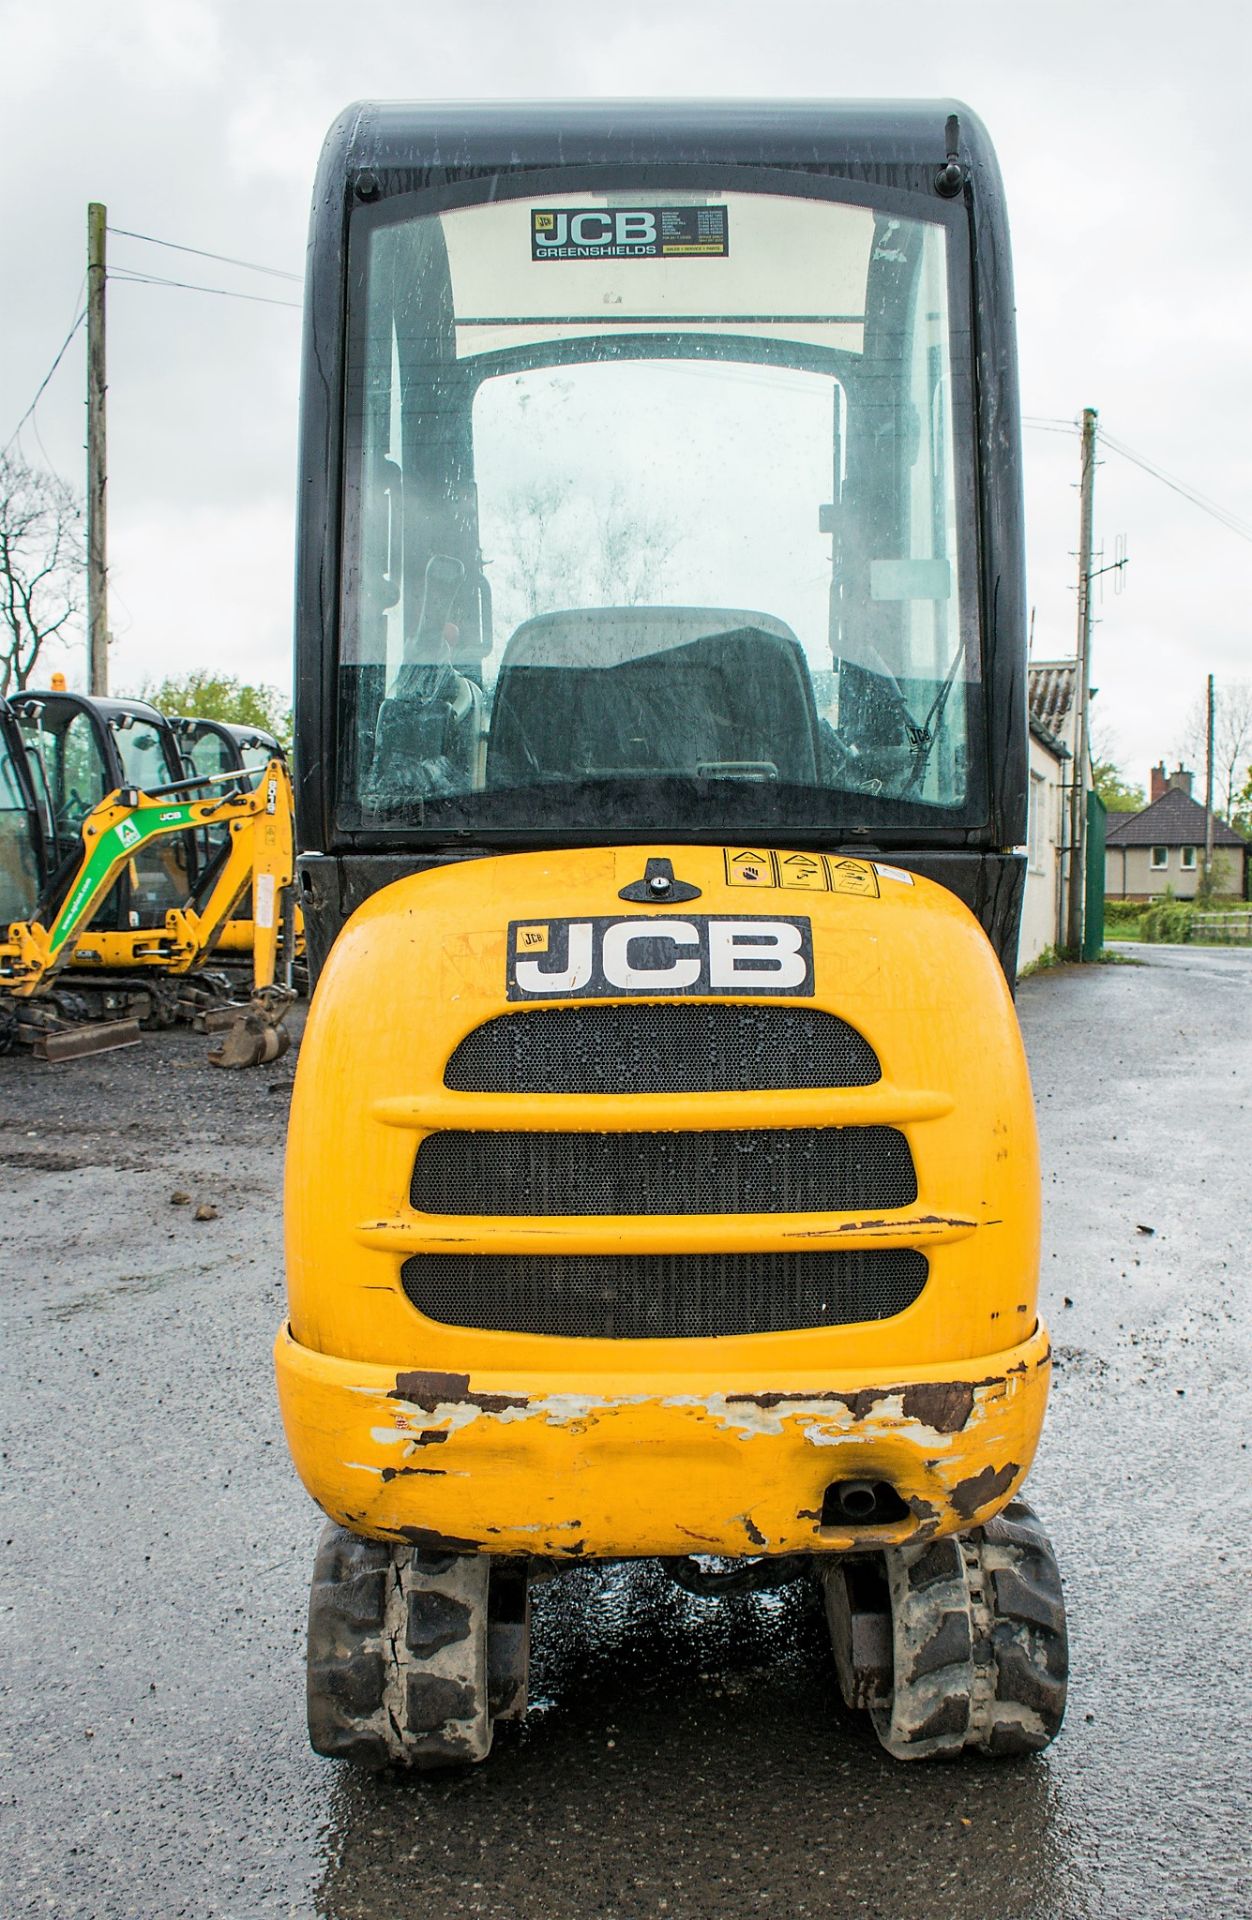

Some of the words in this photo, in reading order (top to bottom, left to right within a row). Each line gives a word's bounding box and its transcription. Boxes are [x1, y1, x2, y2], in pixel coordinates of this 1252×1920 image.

[535, 212, 657, 247] JCB
[536, 245, 657, 258] GREENSHIELDS
[160, 811, 182, 821] JCB
[525, 933, 543, 945] JCB
[516, 920, 807, 993] JCB
